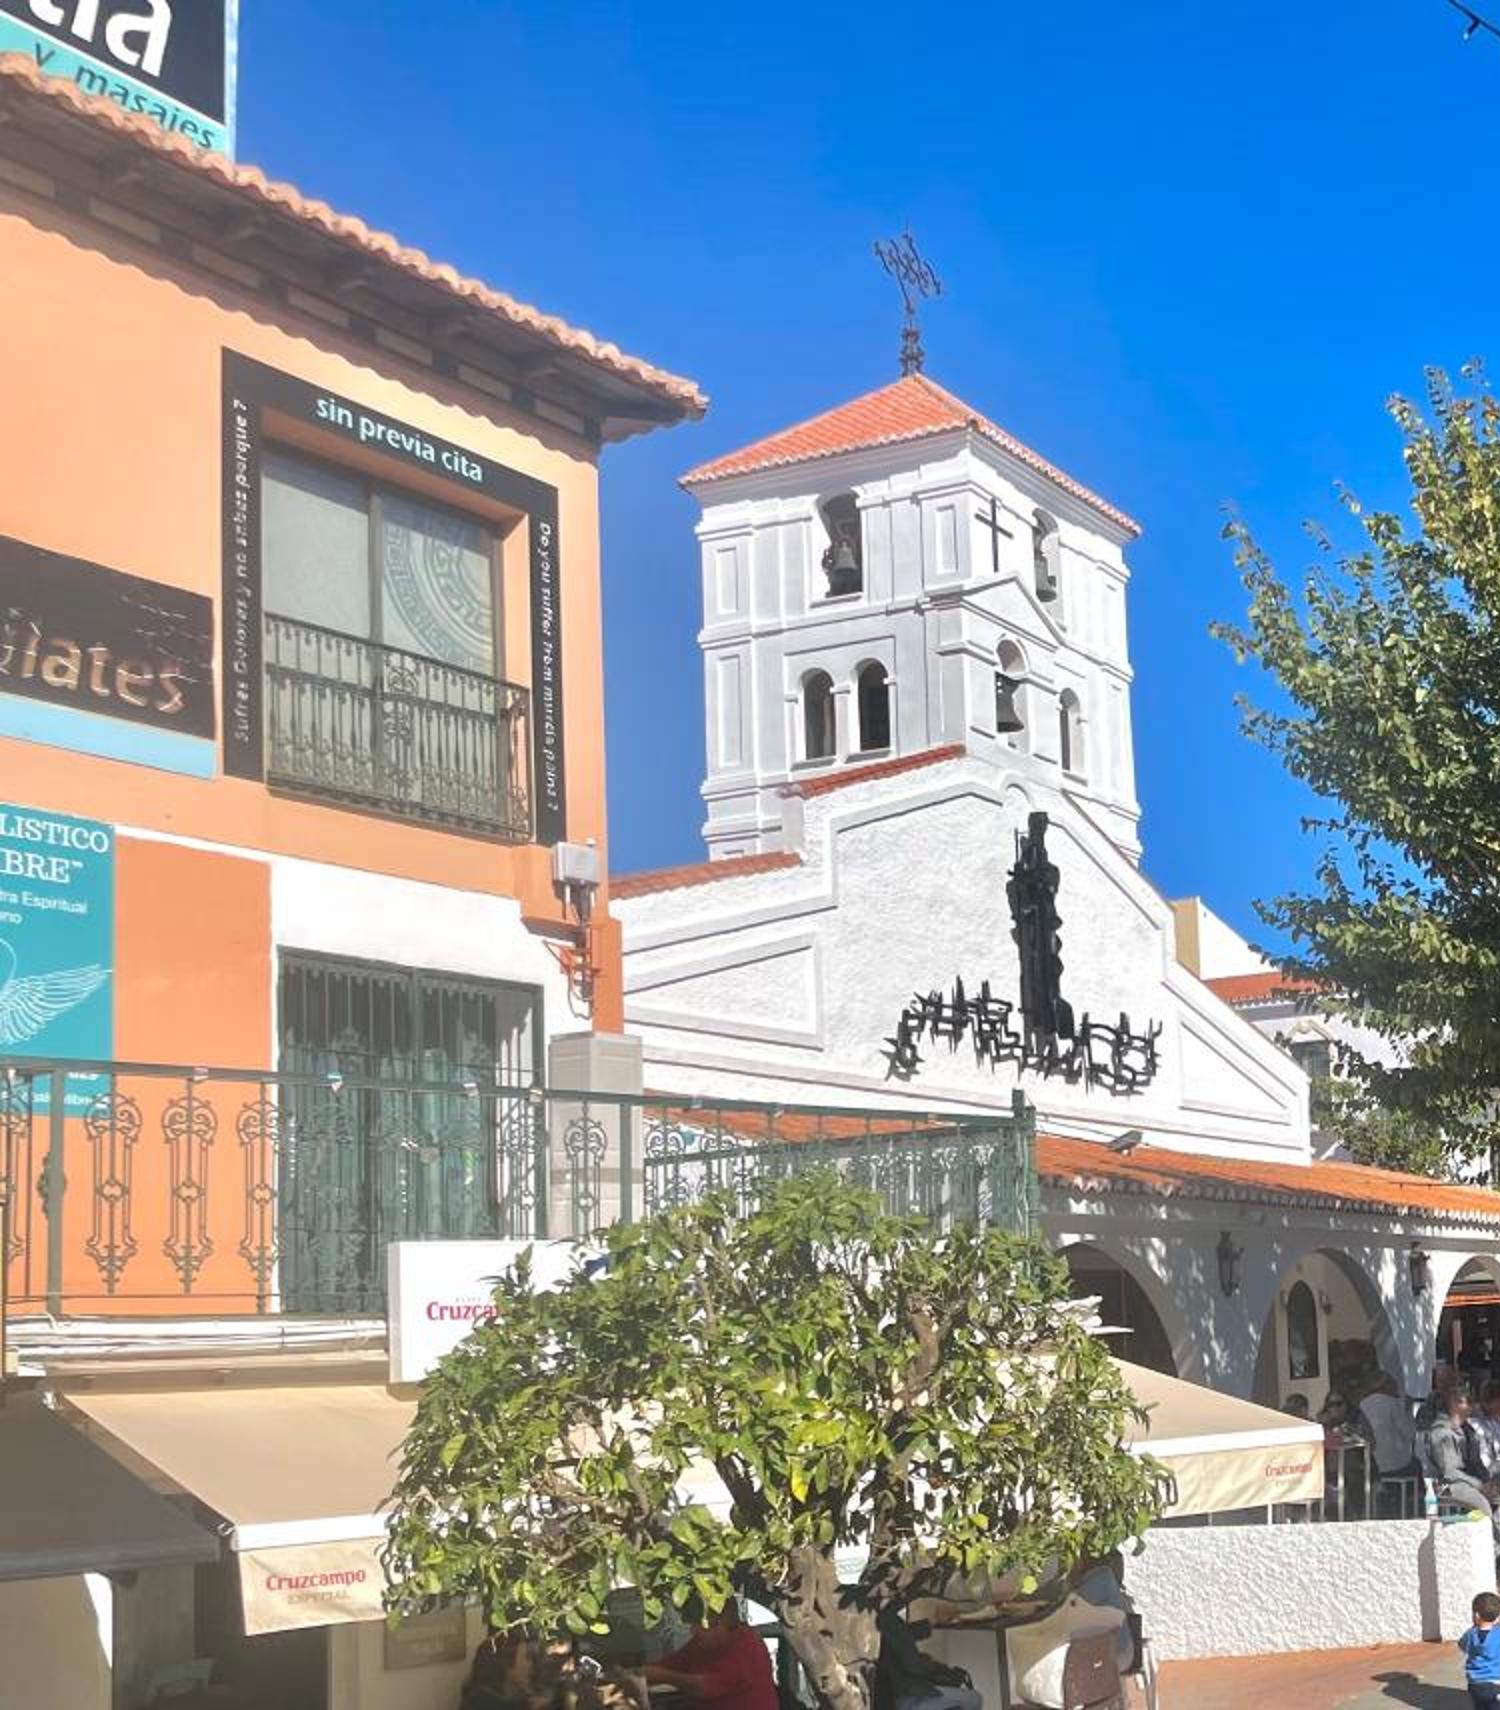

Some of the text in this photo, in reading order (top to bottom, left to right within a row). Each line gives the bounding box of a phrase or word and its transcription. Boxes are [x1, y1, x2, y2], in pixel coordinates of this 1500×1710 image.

[235, 415, 251, 489] porque
[316, 398, 484, 484] sin previa cita
[540, 522, 552, 546] Do
[537, 547, 551, 583] you
[22, 891, 89, 915] Espiritual
[426, 1301, 500, 1321] Cruzca
[265, 1569, 367, 1592] Cruzcampo
